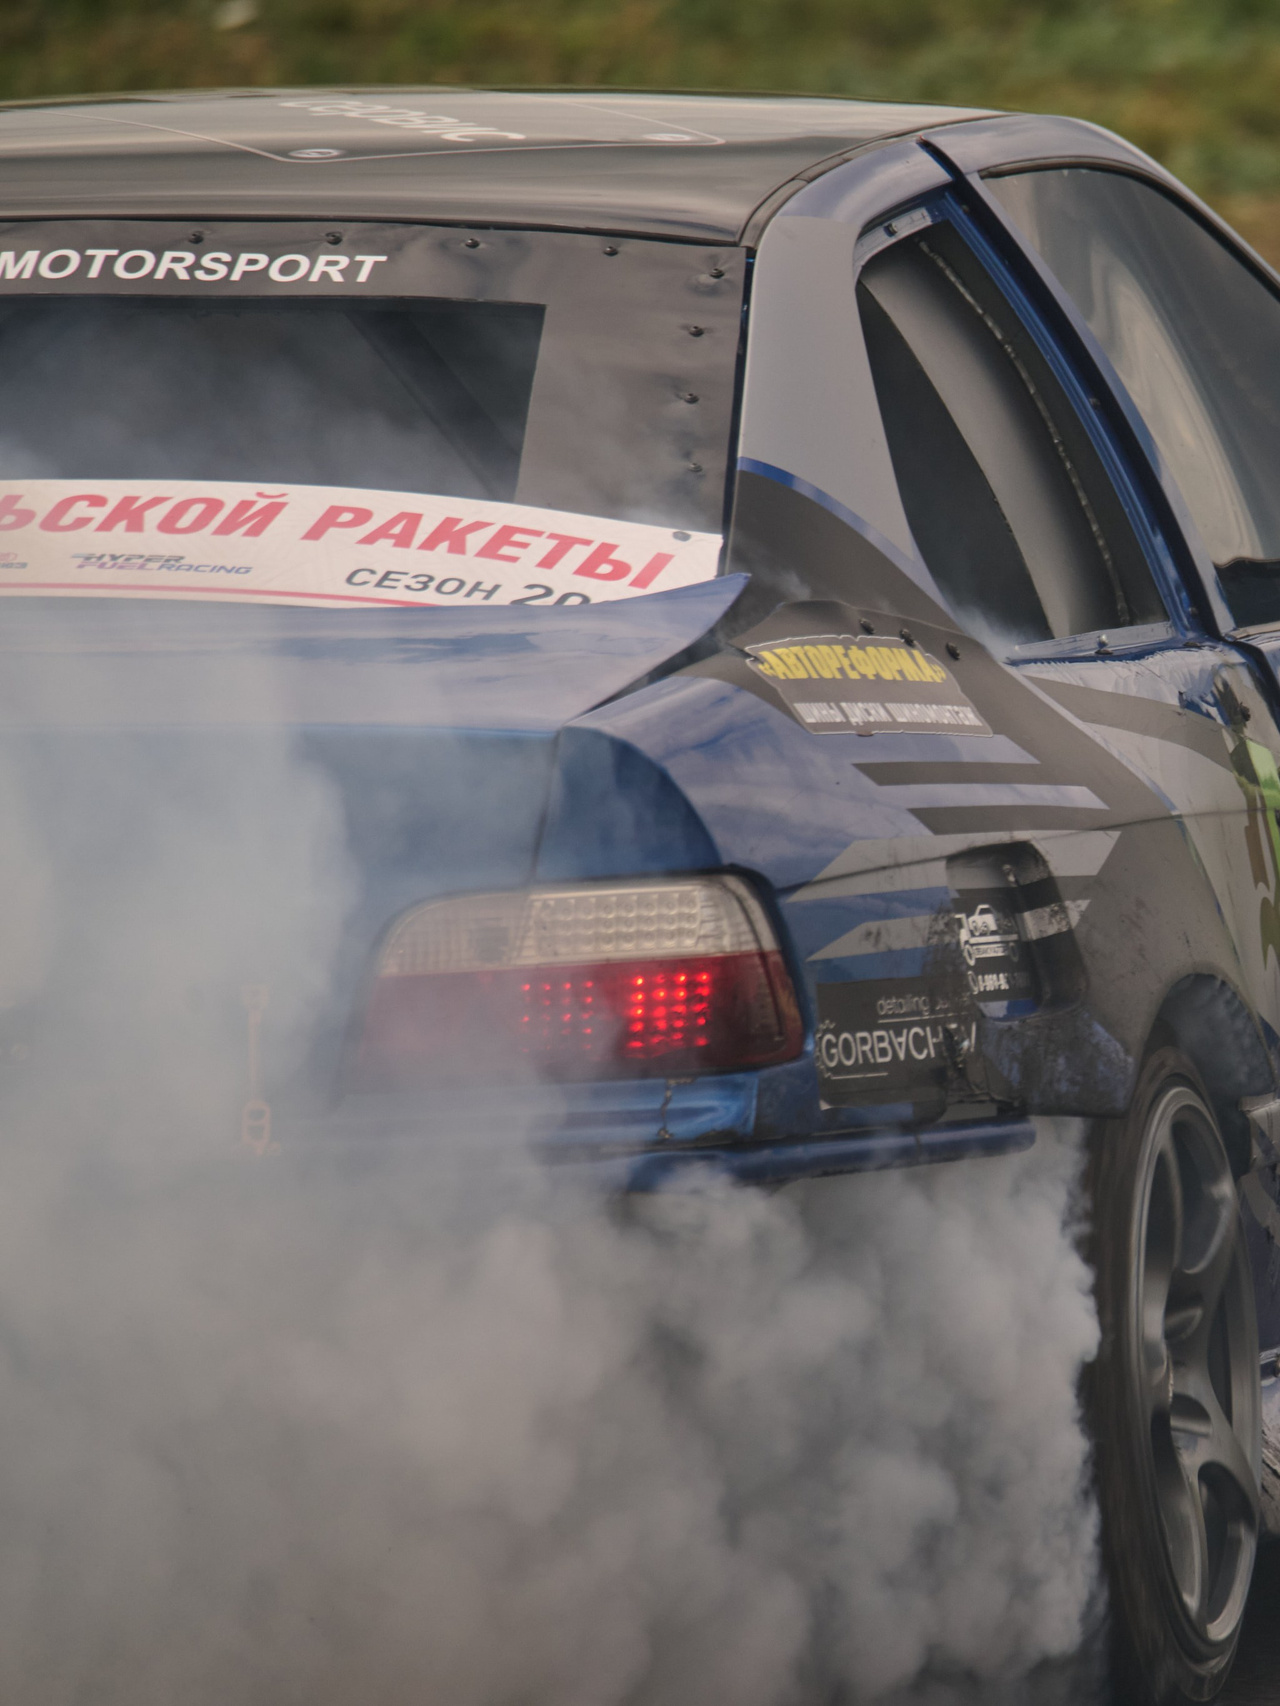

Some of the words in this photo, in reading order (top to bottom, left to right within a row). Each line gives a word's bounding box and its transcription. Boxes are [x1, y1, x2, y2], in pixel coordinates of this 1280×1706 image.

[0, 248, 388, 283] MOTORSPORT
[72, 552, 187, 565] HYPER
[300, 504, 676, 590] РАКЕТЫ
[345, 567, 502, 600] СЕЗОН
